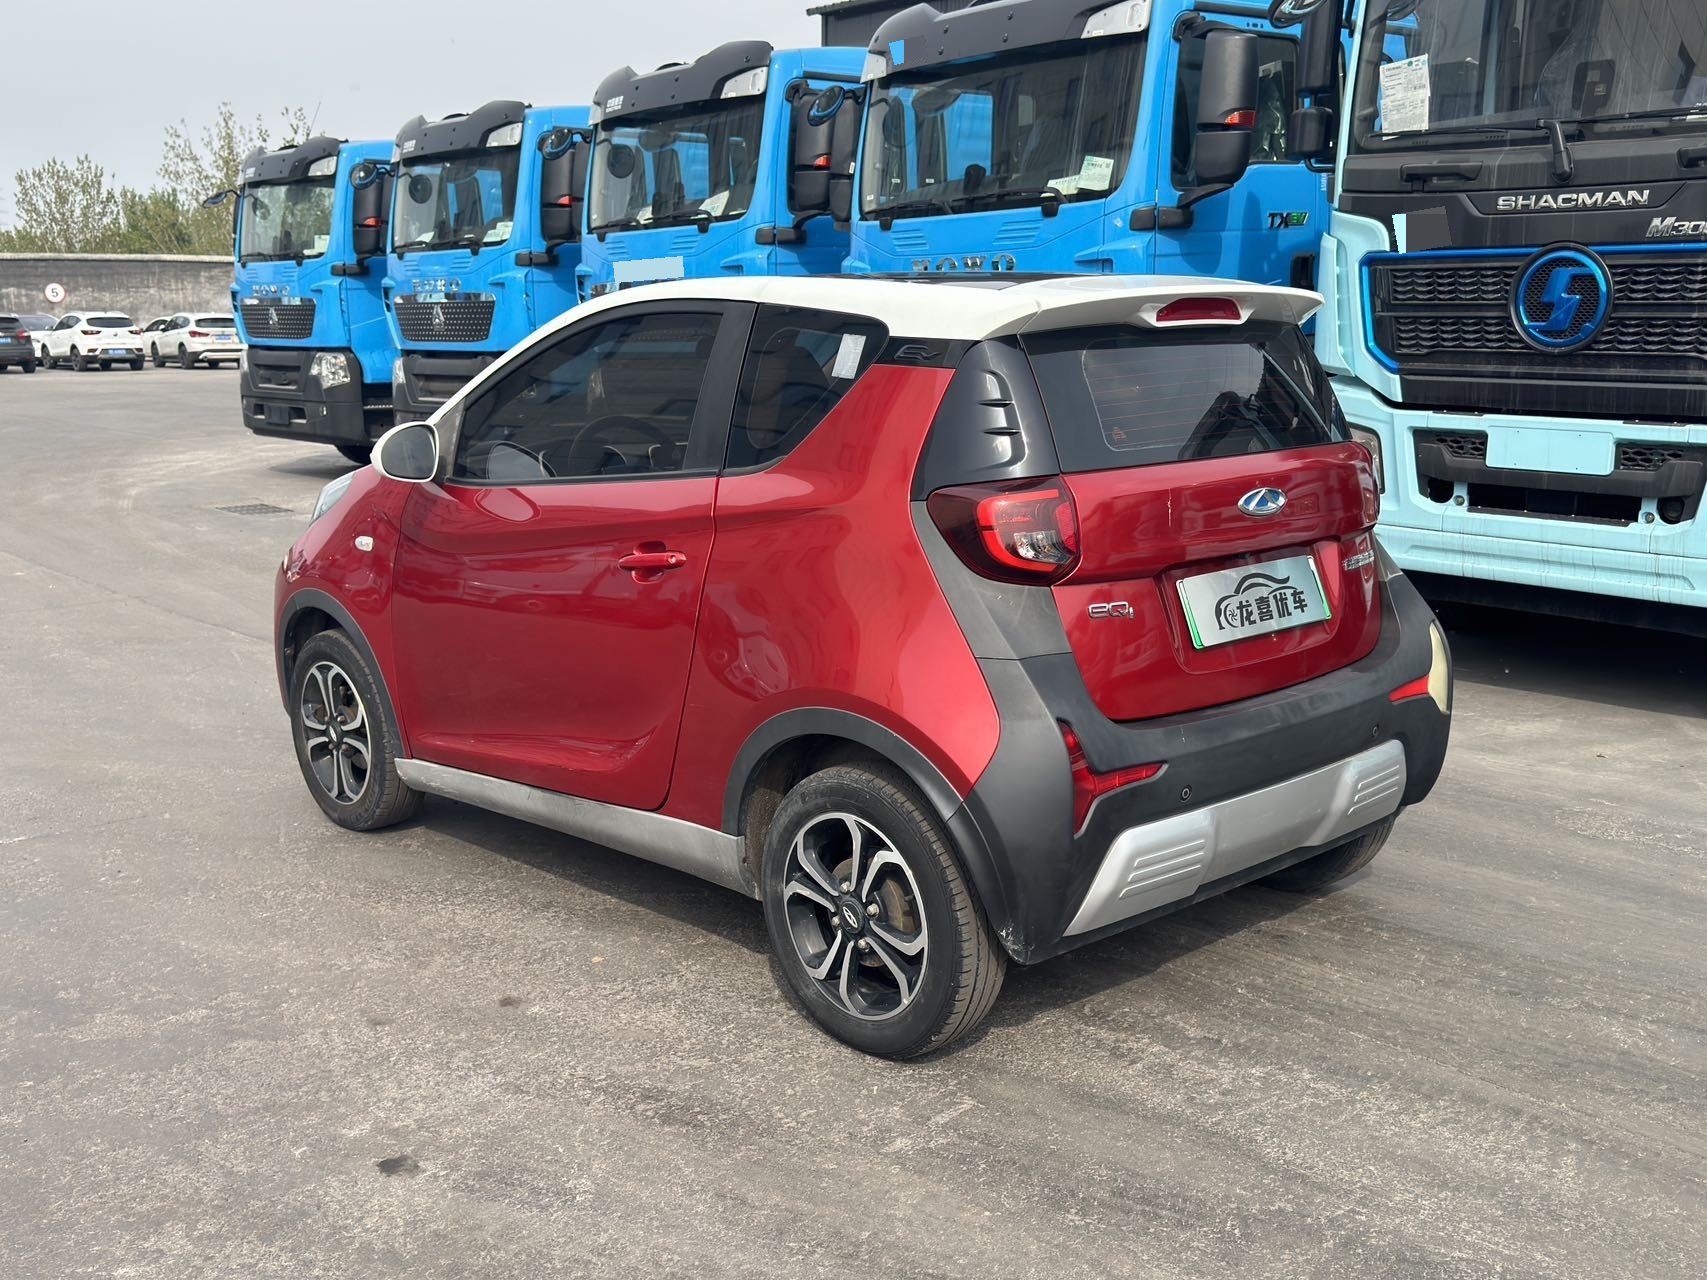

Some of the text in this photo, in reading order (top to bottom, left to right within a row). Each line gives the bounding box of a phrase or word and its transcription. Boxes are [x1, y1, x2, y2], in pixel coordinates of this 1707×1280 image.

[1496, 190, 1650, 211] SHACMAN
[1645, 216, 1707, 238] M30
[51, 287, 59, 298] 5
[1236, 589, 1308, 628] 龙喜优车
